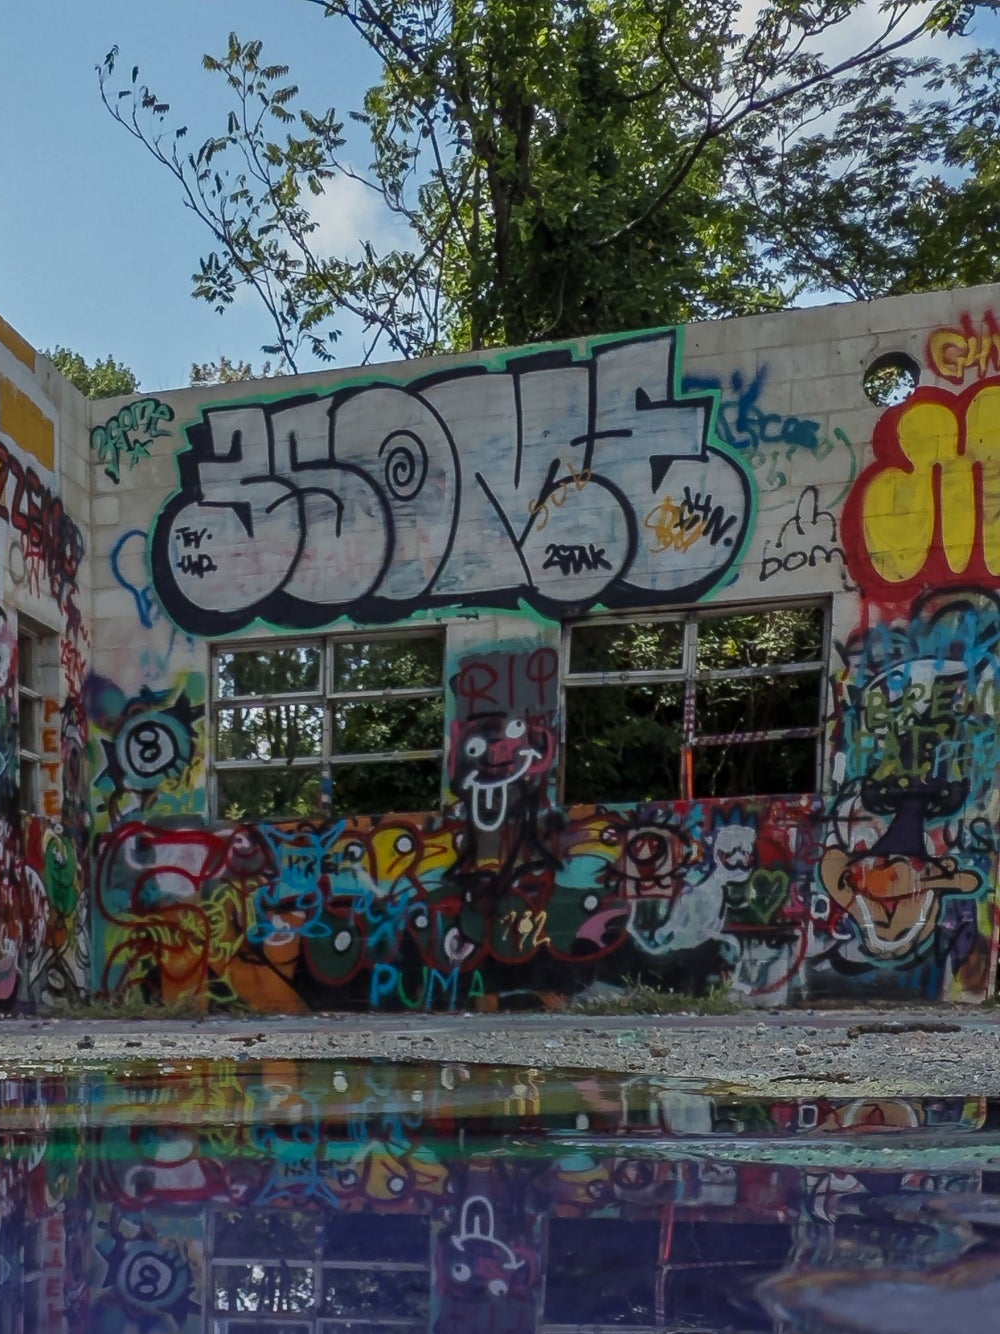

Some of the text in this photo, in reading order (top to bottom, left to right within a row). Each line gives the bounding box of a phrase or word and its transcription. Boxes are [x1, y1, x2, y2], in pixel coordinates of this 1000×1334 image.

[42, 696, 64, 818] PETE
[134, 726, 163, 764] 8
[369, 962, 486, 1011] PUMA
